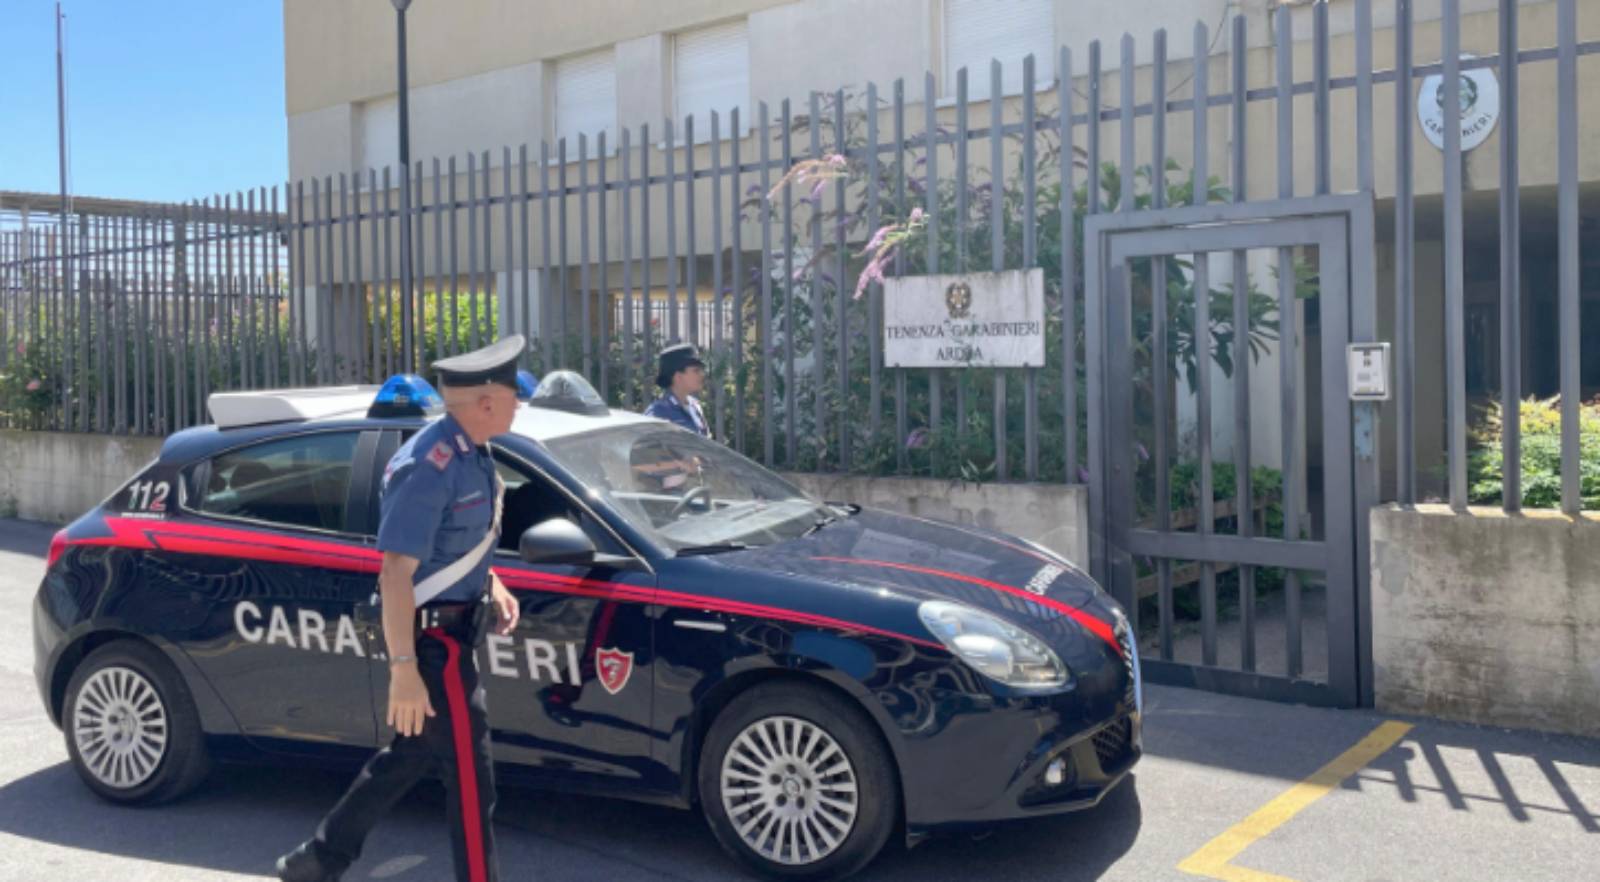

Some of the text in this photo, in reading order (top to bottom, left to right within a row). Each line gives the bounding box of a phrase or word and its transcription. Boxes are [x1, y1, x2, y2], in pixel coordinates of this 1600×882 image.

[1425, 112, 1492, 137] CARNIERI
[887, 324, 945, 339] TENENZA
[128, 480, 170, 511] 112
[233, 600, 582, 686] CARAERI
